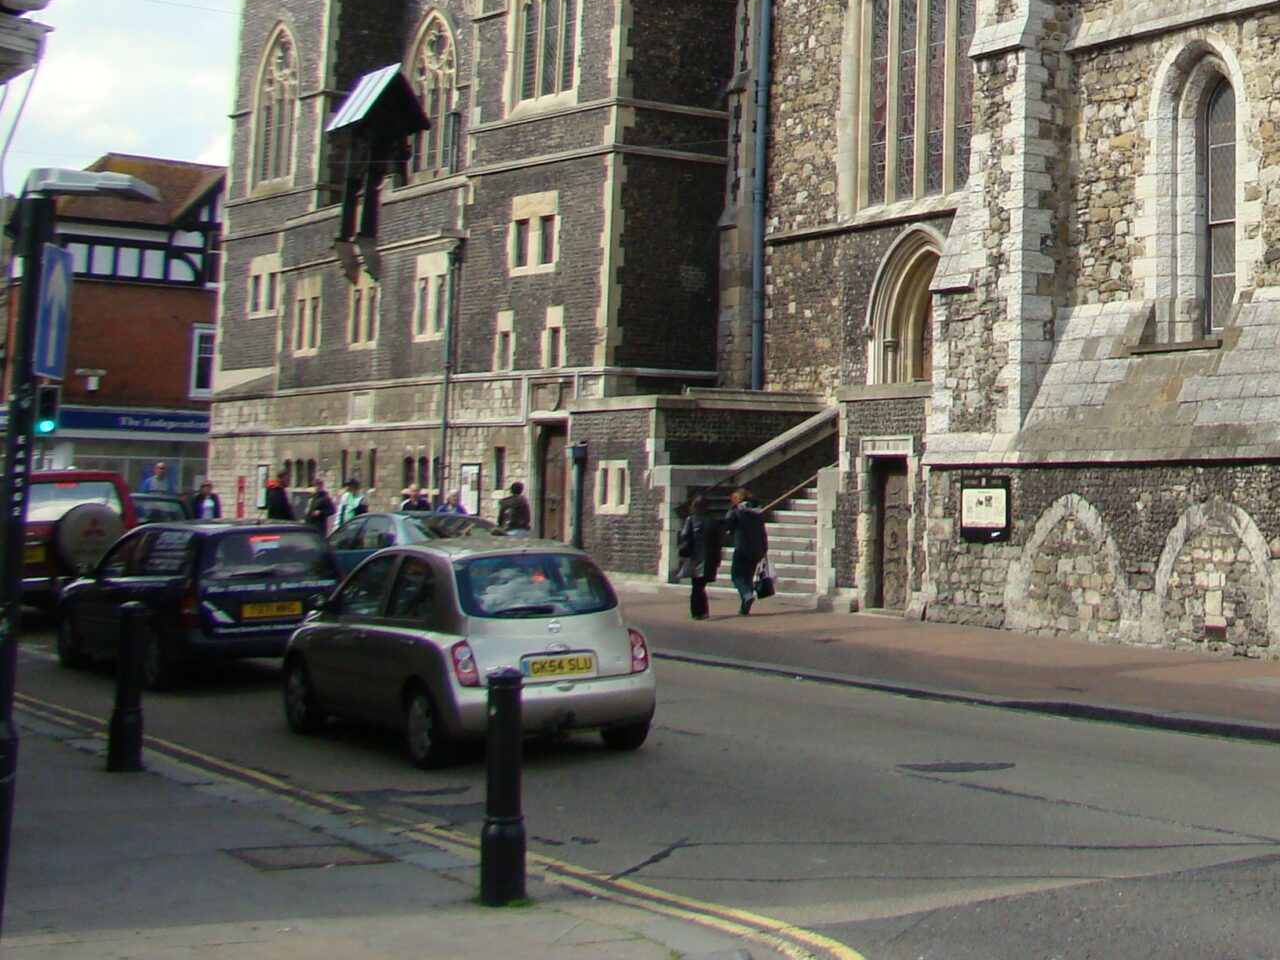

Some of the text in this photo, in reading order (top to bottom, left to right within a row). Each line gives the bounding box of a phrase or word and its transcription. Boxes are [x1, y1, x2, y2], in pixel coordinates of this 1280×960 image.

[118, 416, 208, 430] The Independen
[531, 655, 593, 674] GK54 SLU
